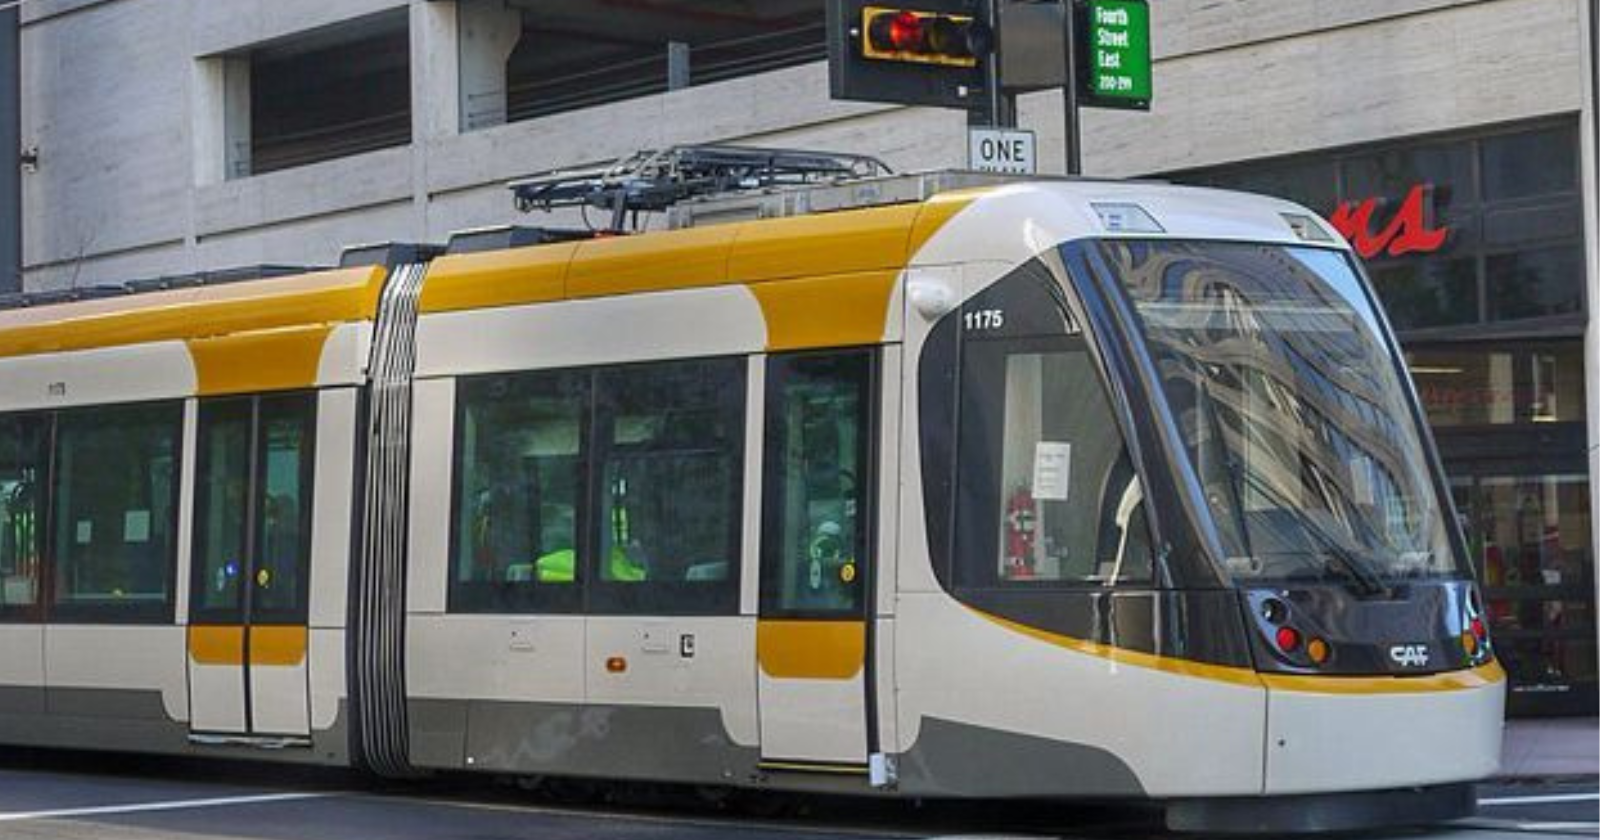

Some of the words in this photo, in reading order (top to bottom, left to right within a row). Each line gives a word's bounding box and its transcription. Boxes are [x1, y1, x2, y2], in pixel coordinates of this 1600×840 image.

[1095, 6, 1127, 26] Fourth
[1098, 27, 1129, 48] Street
[1098, 50, 1119, 69] East
[981, 138, 1024, 162] ONE
[964, 310, 1004, 330] 1175
